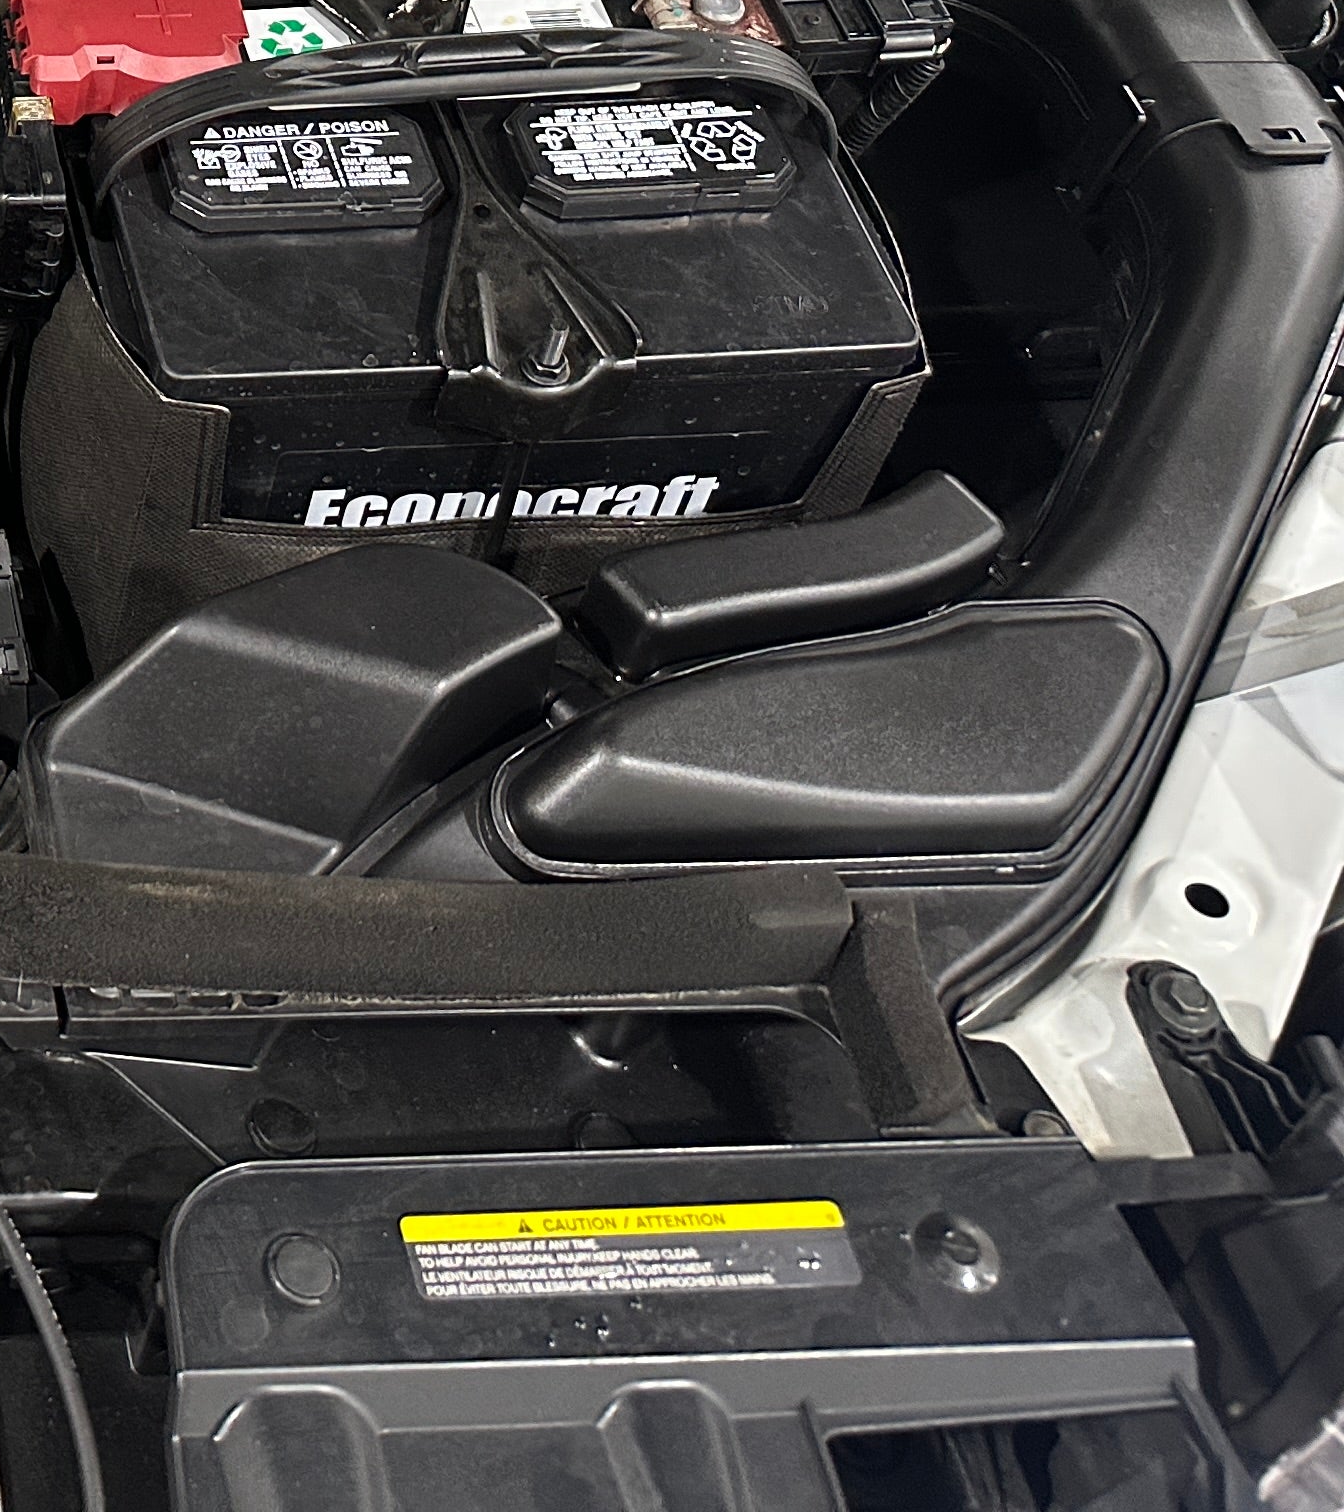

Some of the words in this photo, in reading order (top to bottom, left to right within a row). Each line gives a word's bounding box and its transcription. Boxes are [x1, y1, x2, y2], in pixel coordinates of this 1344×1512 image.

[223, 124, 300, 138] DANGER
[320, 120, 389, 134] POISON
[543, 1217, 617, 1232] CAUTION
[637, 1213, 726, 1229] ATTENTION
[415, 1244, 437, 1255] FAN
[438, 1243, 473, 1254] BLADE
[474, 1242, 498, 1252] CAN
[499, 1241, 532, 1252] START
[533, 1240, 548, 1251] AT
[549, 1240, 569, 1250] ANY
[418, 1257, 434, 1268] TO
[436, 1256, 464, 1268] HELP
[465, 1255, 497, 1267] AVOID
[499, 1253, 556, 1266] PERSONAL
[623, 1248, 660, 1260] HANDS
[422, 1271, 437, 1283] LE
[438, 1269, 505, 1282] VENTILATEUR
[549, 1267, 564, 1279] DE
[426, 1284, 458, 1296] POUR
[496, 1283, 531, 1294] TOUTE
[609, 1279, 632, 1290] PAS
[632, 1276, 649, 1289] EN
[650, 1275, 716, 1288] APPROCHER
[717, 1274, 737, 1286] LES
